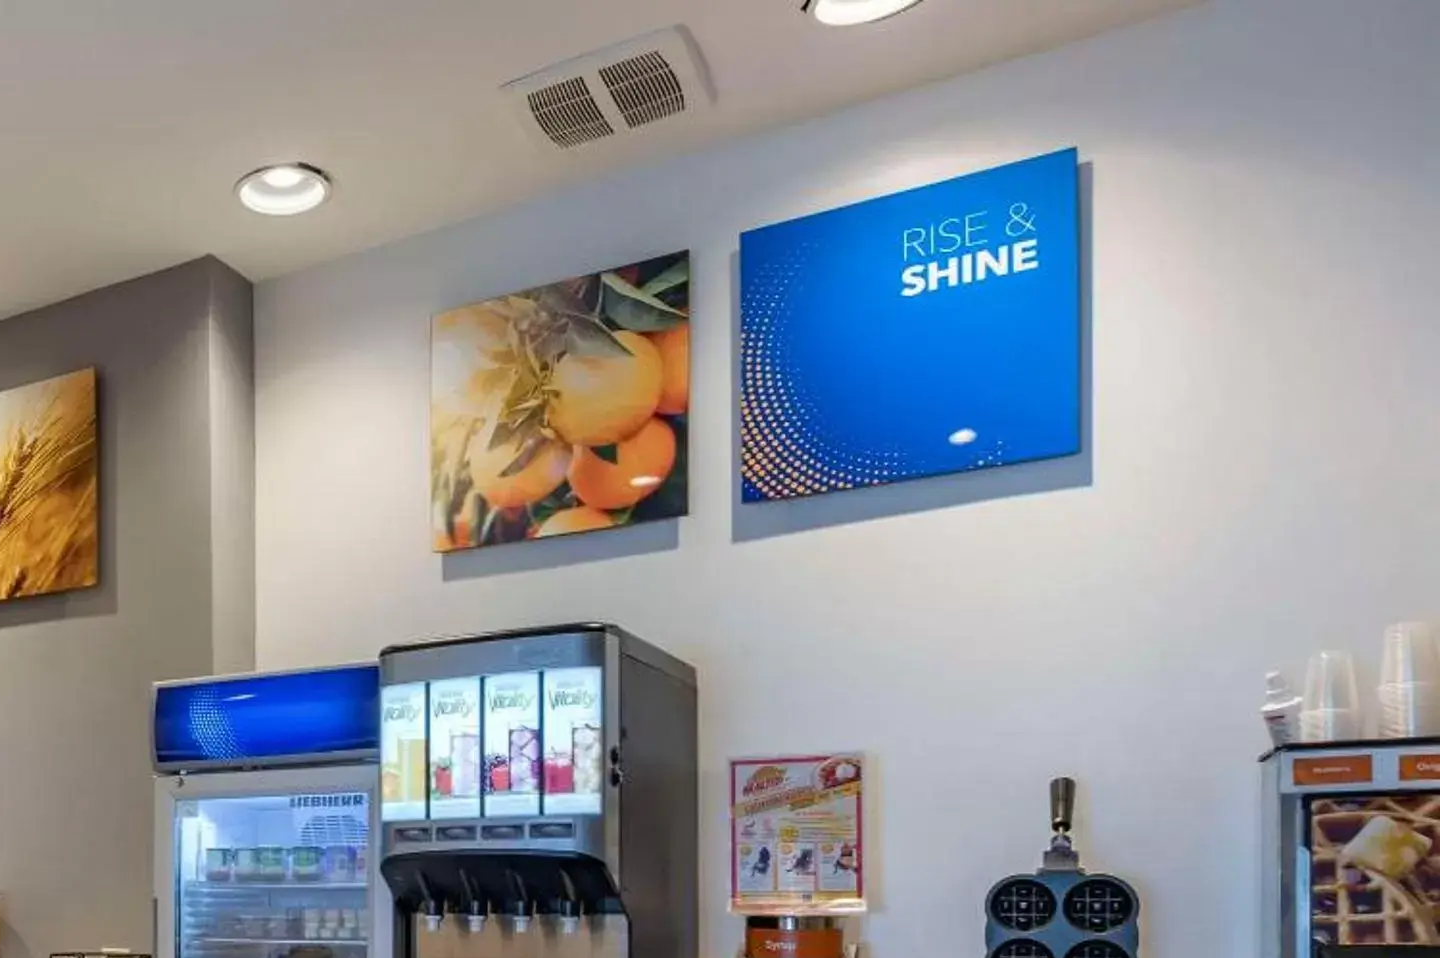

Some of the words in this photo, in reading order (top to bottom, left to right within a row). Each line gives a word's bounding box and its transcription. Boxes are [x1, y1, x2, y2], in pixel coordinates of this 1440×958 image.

[903, 210, 988, 262] RISE
[1005, 202, 1036, 237] &
[900, 239, 1039, 297] SHINE
[548, 689, 596, 711] Vitality
